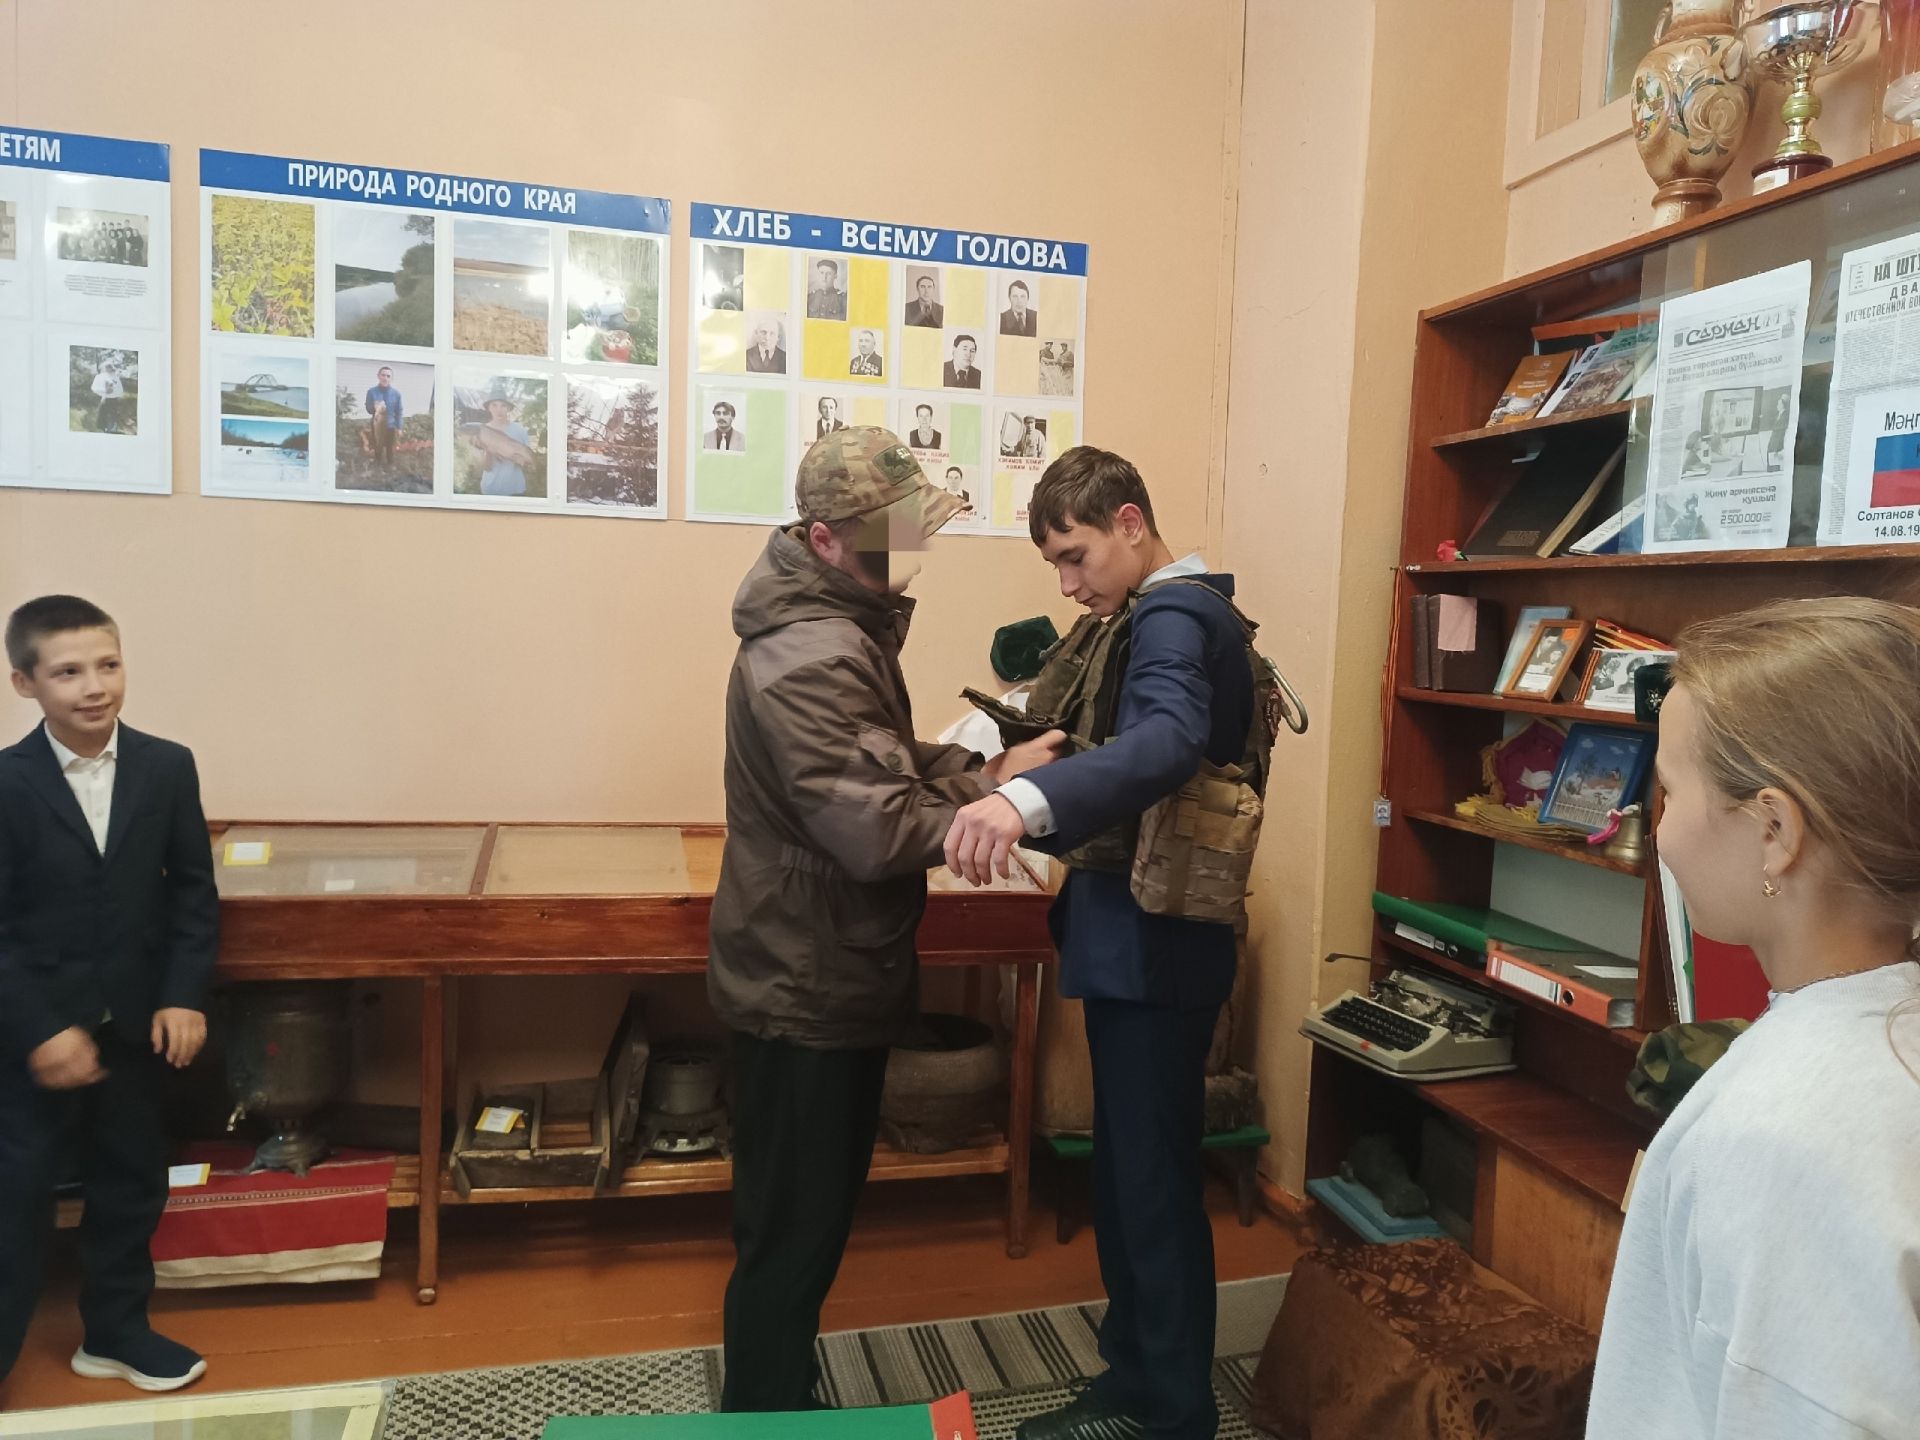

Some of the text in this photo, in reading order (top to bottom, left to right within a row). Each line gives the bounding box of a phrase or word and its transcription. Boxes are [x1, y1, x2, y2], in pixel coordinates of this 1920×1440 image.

[0, 132, 60, 163] ЕТЯМ
[288, 163, 576, 214] ПРИРОДА РОДНОГО КРАЯ
[713, 208, 791, 240] ХЛЕБ
[841, 221, 938, 256] ВСЕМУ
[956, 234, 1068, 270] ГОЛОВА
[1873, 261, 1891, 282] НА
[1895, 253, 1920, 276] ШТ
[1857, 509, 1914, 521] Солтанов
